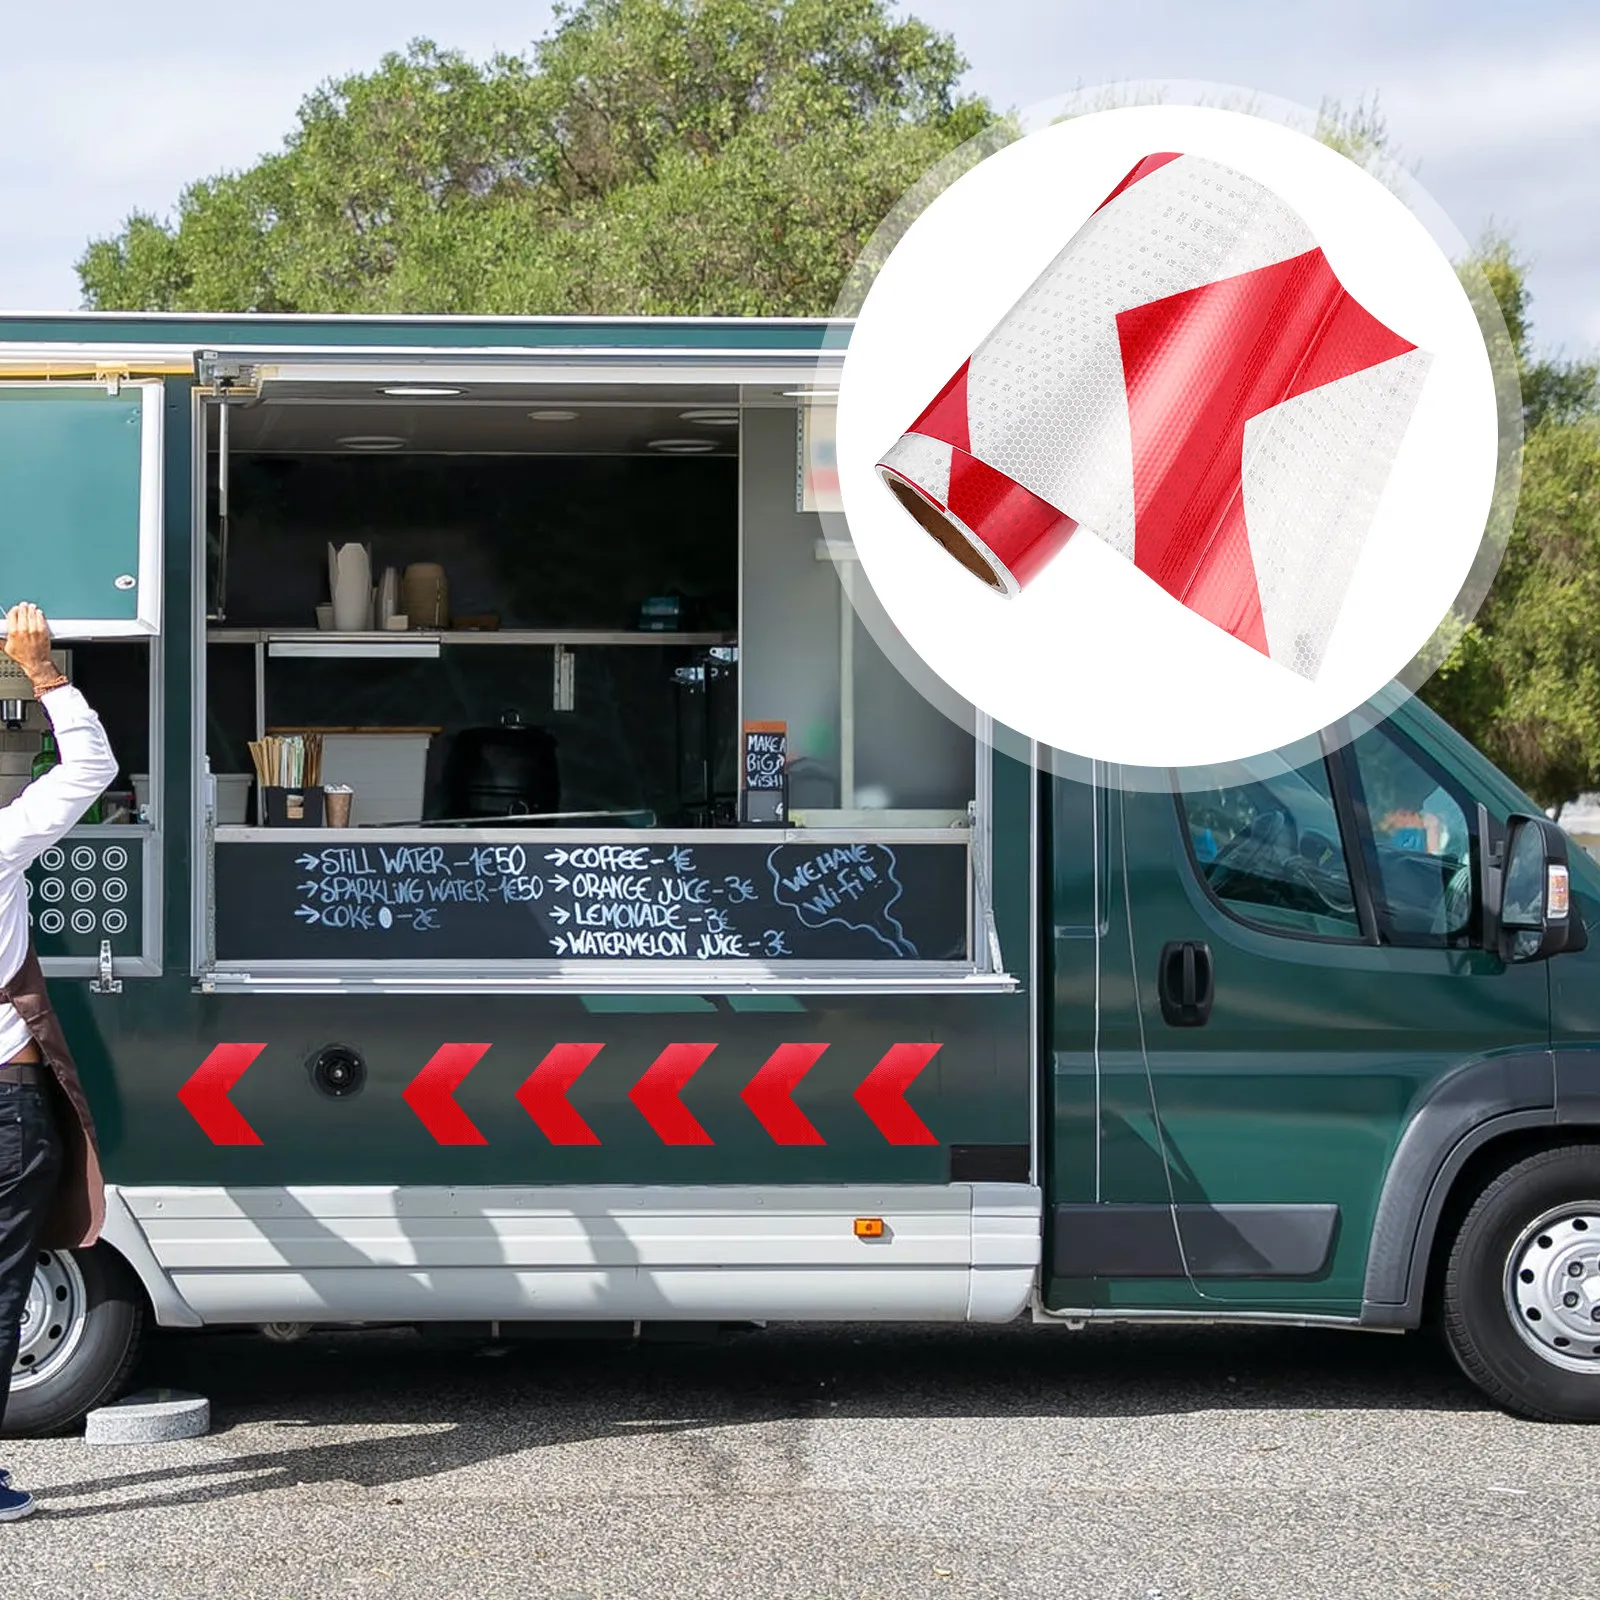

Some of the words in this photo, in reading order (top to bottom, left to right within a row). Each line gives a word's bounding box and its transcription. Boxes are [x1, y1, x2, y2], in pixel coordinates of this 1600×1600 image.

[748, 734, 780, 753] MAKE
[380, 846, 451, 875] WATER
[569, 845, 650, 872] COFFEE
[782, 861, 822, 892] WE
[815, 844, 874, 874] HAVE
[427, 879, 490, 902] WATER
[572, 873, 652, 901] ORANGE
[321, 905, 376, 929] COKE
[574, 902, 687, 930] LEMONADE
[566, 931, 687, 956] WATERMELON
